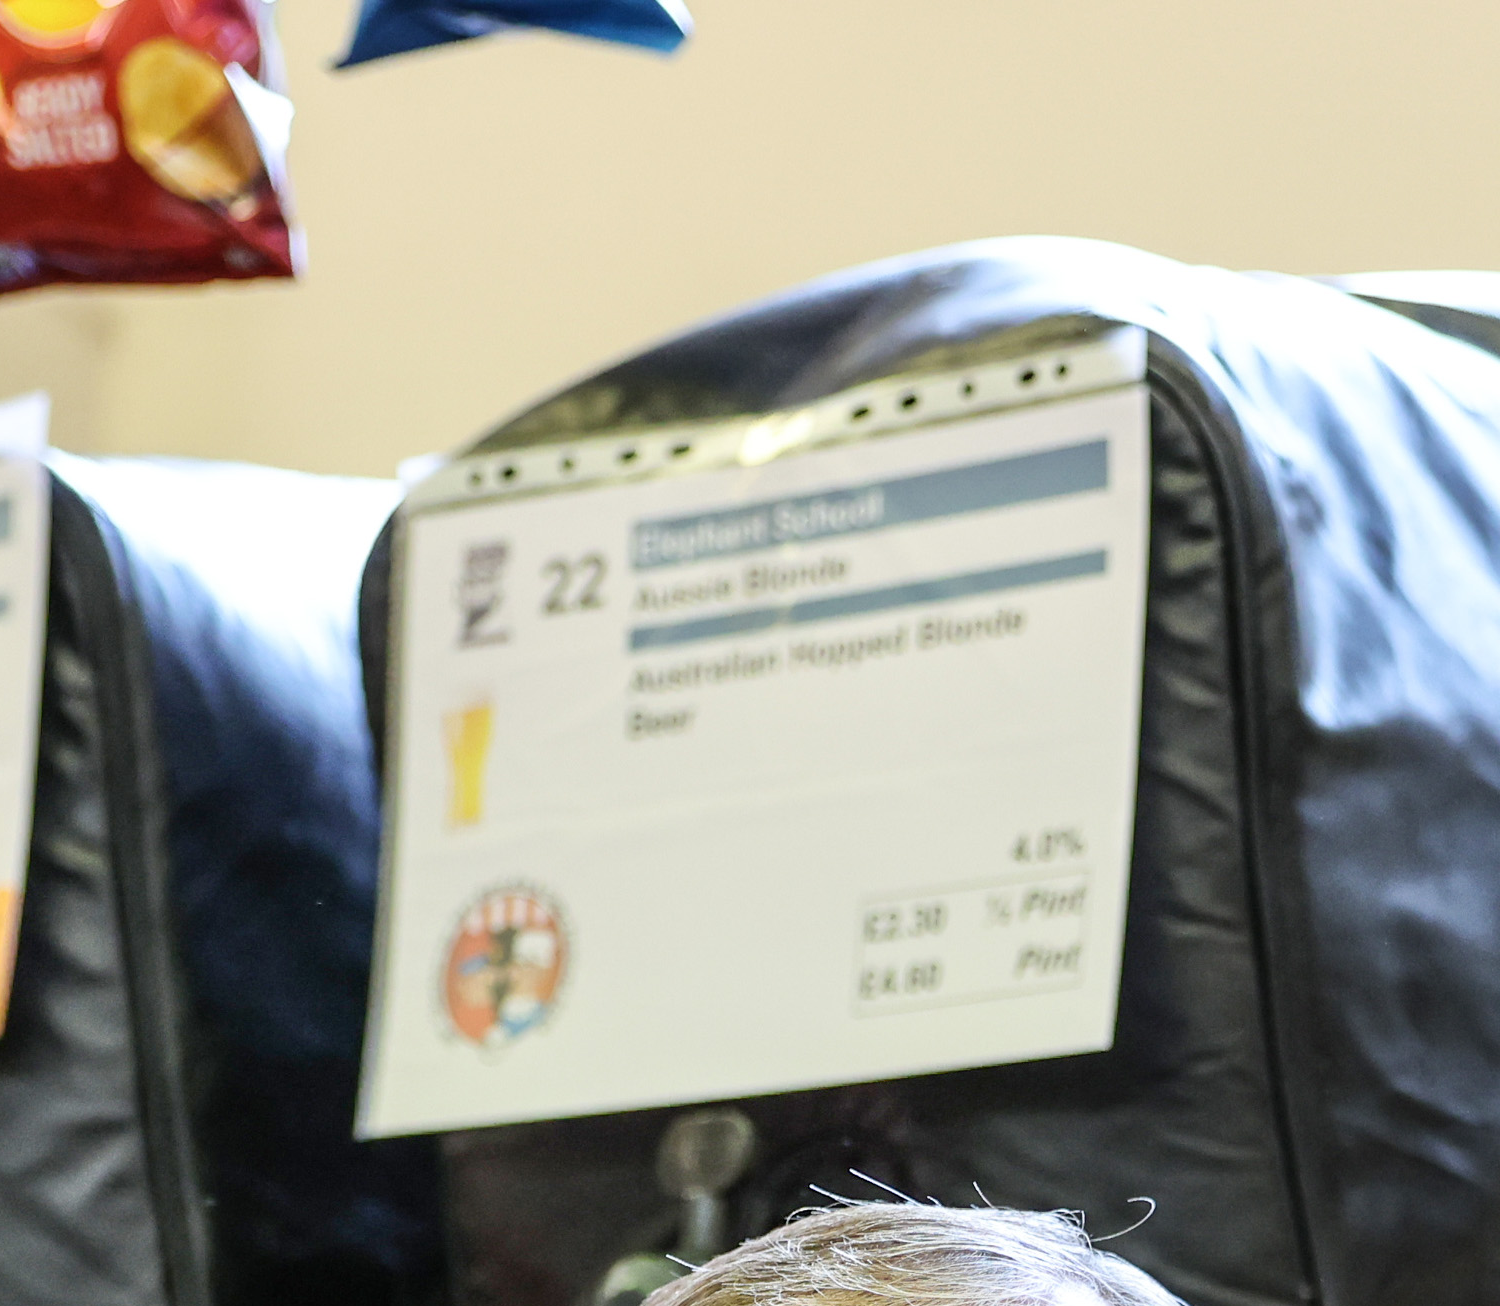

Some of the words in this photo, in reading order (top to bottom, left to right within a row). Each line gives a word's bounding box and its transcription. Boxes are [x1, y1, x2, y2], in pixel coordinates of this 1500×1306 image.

[771, 491, 886, 541] School
[541, 556, 608, 615] 22
[742, 557, 852, 600] Blonde
[627, 648, 780, 696] Australian
[786, 625, 909, 674] Hopped
[914, 607, 1030, 648] Blonde
[627, 705, 695, 742] Beer
[1019, 884, 1088, 920] Pint
[1012, 943, 1083, 979] Pint
